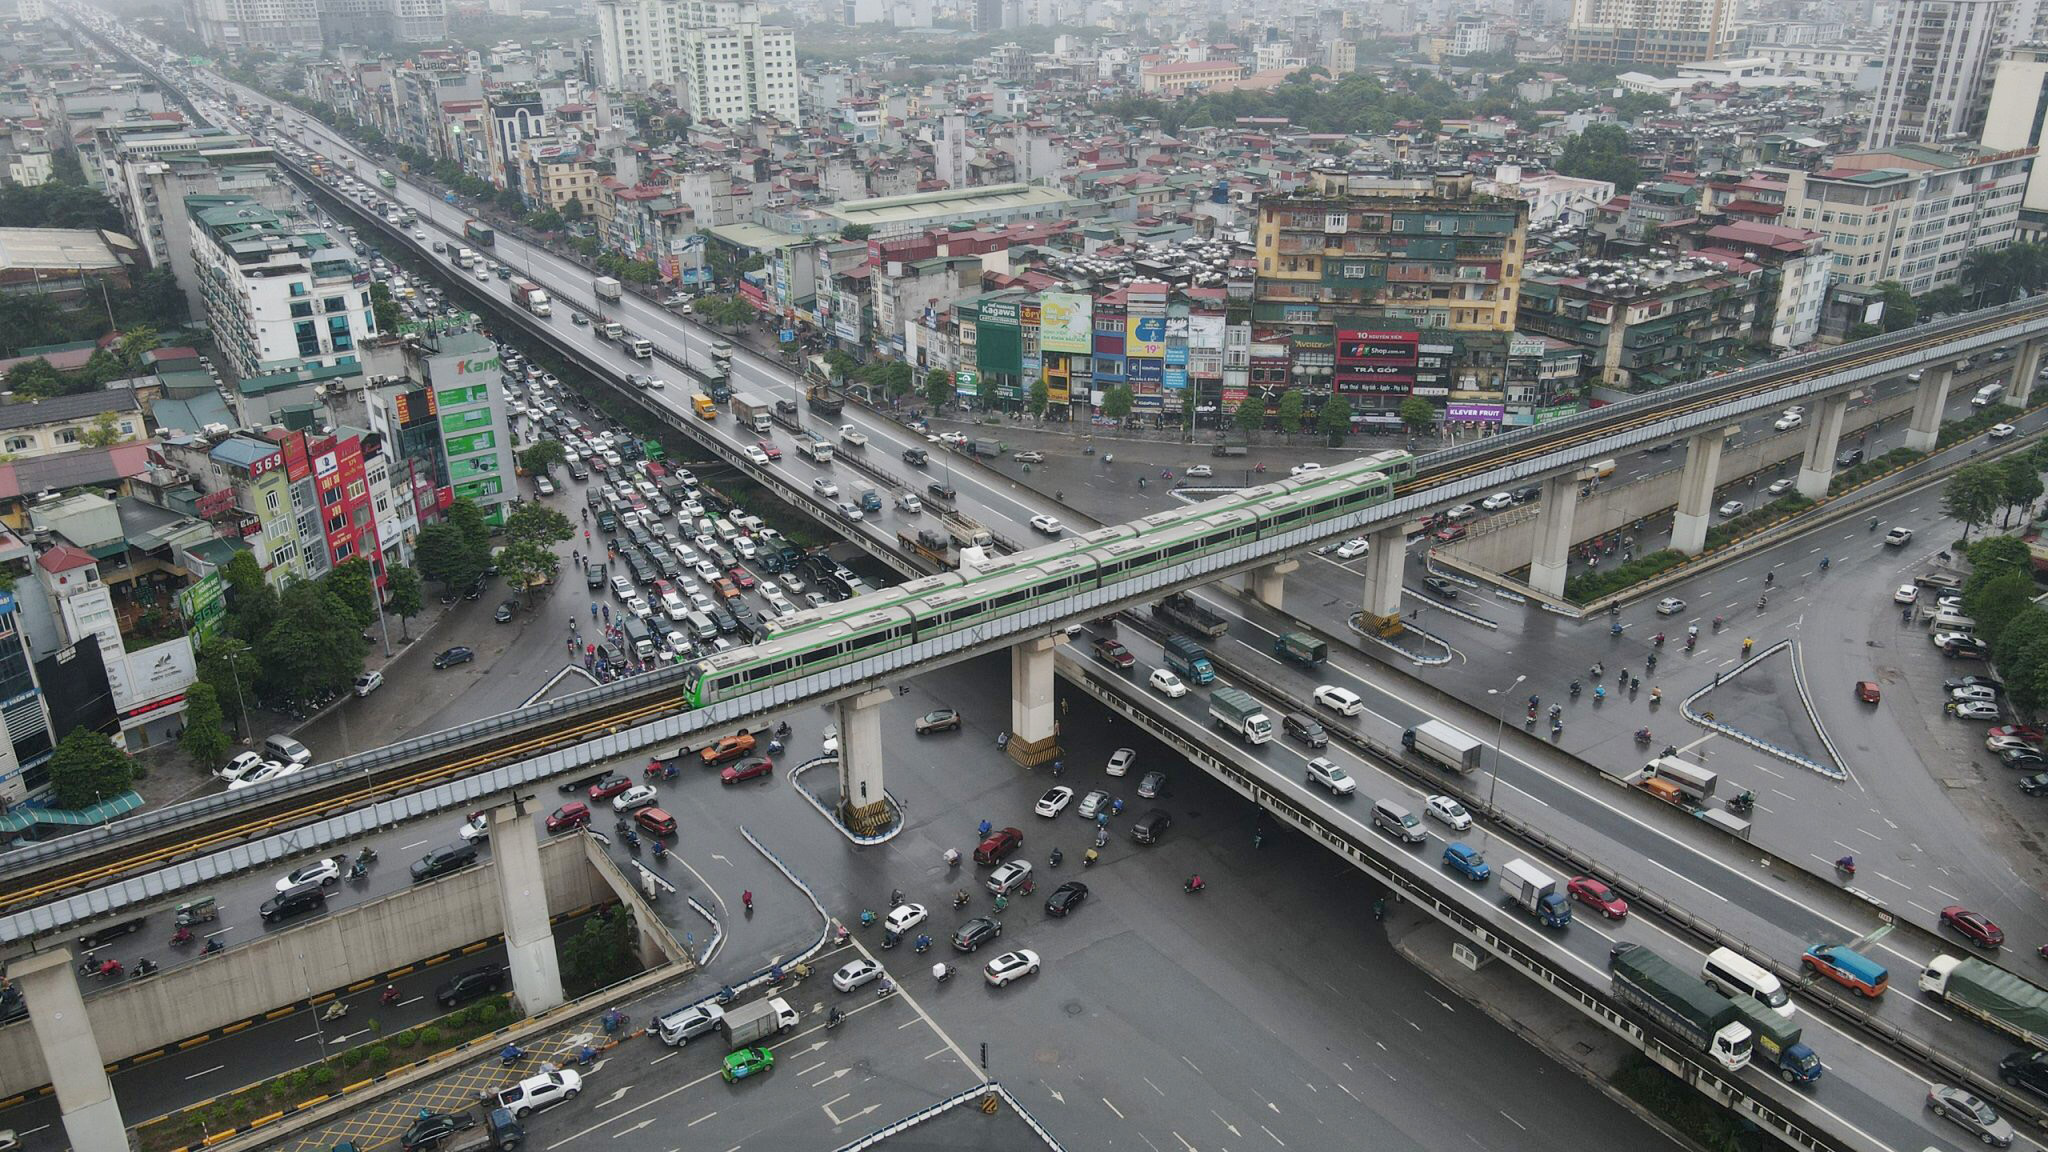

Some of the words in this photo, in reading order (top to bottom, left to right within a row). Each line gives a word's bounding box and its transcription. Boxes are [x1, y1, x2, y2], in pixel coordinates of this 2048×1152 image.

[415, 61, 447, 71] RUBIC
[982, 305, 1016, 316] Kagawa
[1351, 344, 1371, 356] FPT
[1377, 365, 1398, 373] GÓP
[255, 453, 281, 475] 369
